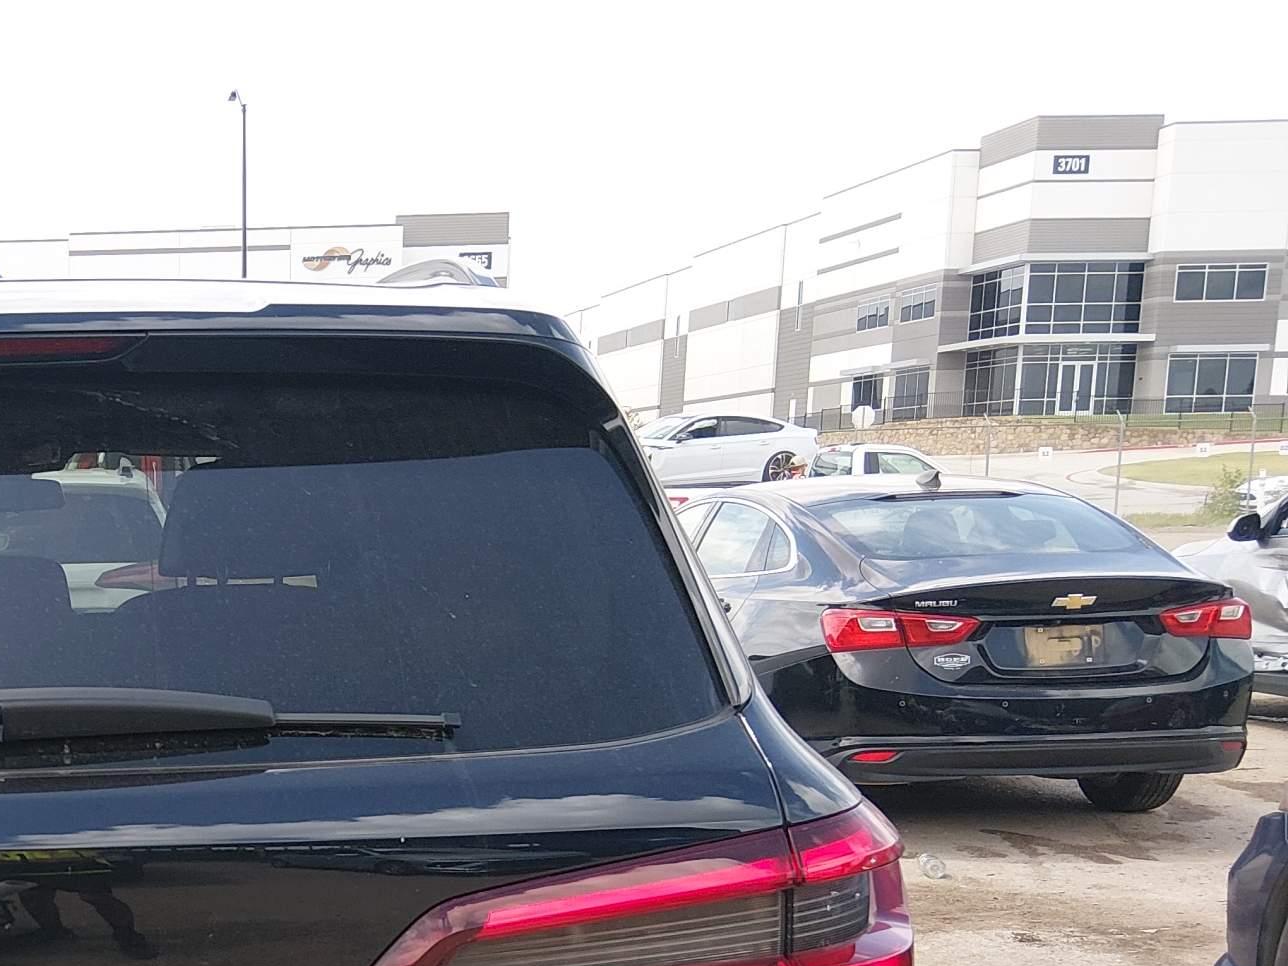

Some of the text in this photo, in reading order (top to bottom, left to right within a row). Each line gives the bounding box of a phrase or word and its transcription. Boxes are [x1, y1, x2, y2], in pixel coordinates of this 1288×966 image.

[1057, 158, 1086, 172] 3701
[347, 248, 392, 274] Graphics
[915, 600, 958, 608] MALIBU
